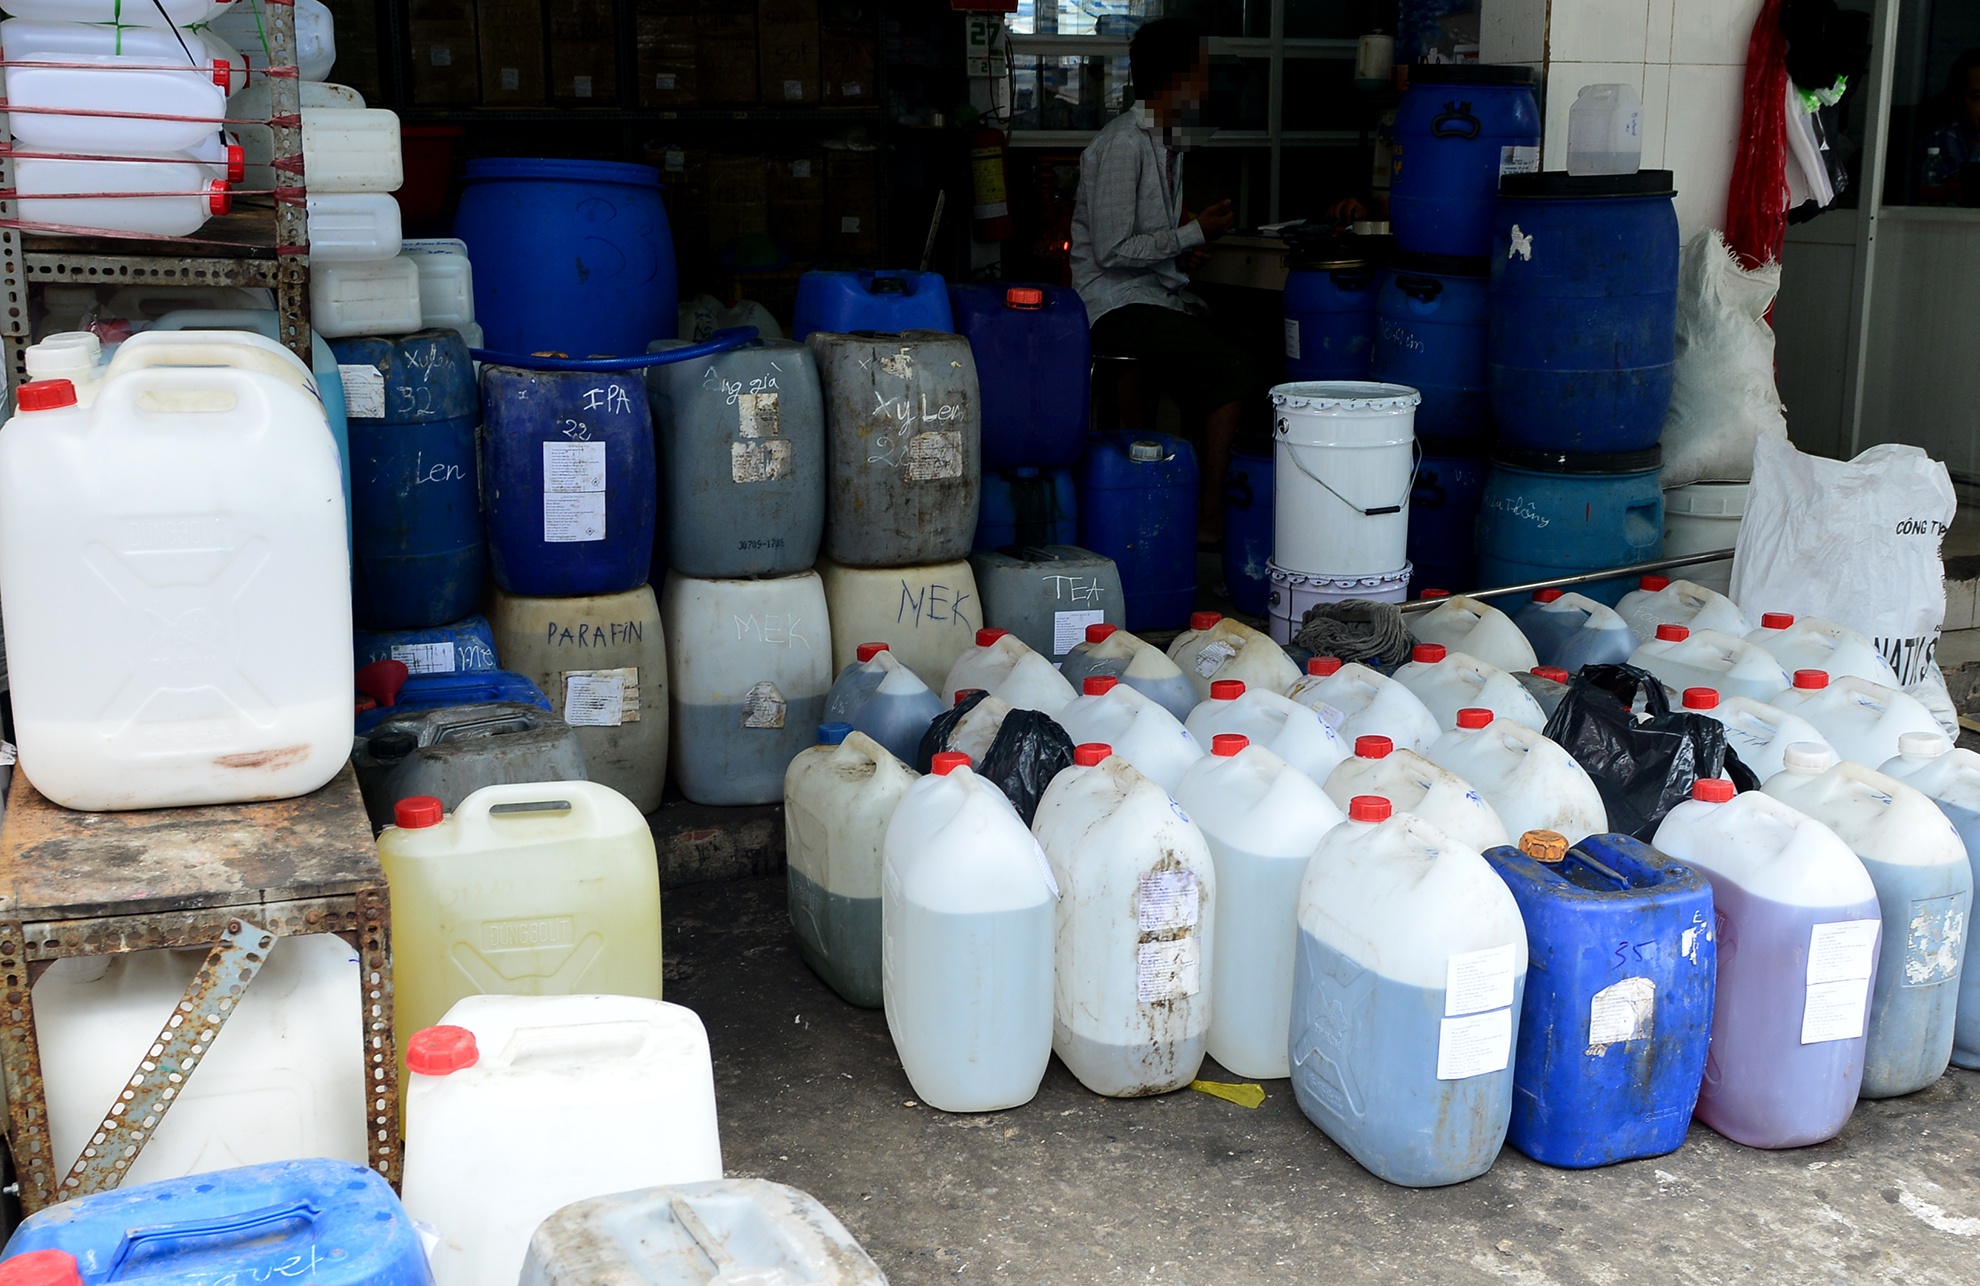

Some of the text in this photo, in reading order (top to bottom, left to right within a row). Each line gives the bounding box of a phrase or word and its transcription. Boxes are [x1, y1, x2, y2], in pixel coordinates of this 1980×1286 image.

[397, 386, 436, 415] 32
[582, 383, 631, 414] IPA
[1895, 517, 1928, 535] CÔNG
[1042, 575, 1105, 602] TEA
[897, 578, 973, 636] MEK
[733, 612, 811, 650] MEK
